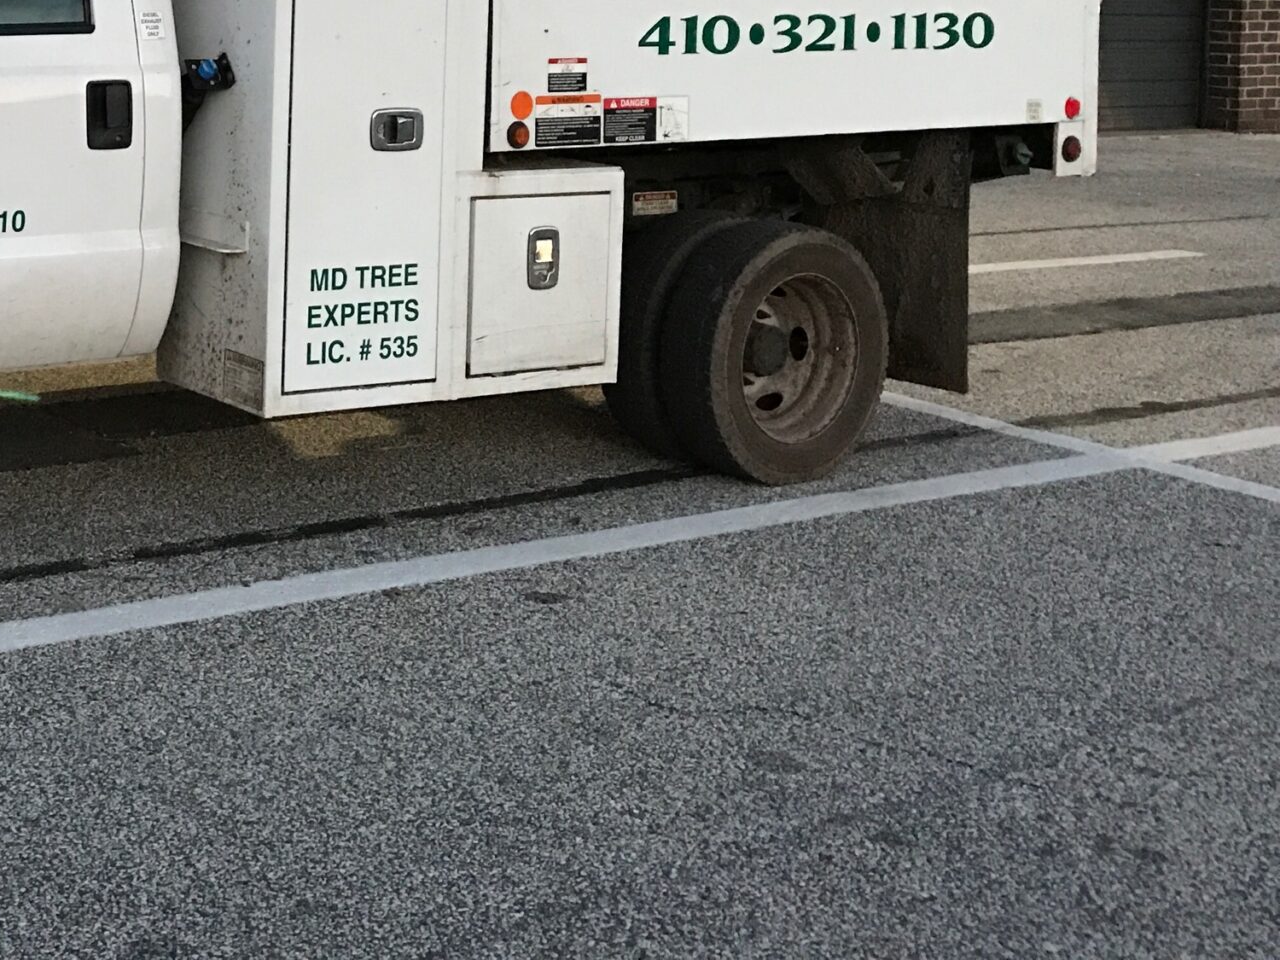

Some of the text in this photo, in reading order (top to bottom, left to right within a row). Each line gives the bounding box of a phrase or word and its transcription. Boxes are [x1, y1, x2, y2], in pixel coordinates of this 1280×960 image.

[620, 98, 650, 107] DANGER
[309, 263, 419, 292] MD TREE
[307, 298, 420, 329] EXPERTS
[306, 335, 419, 365] LIC. # 535
